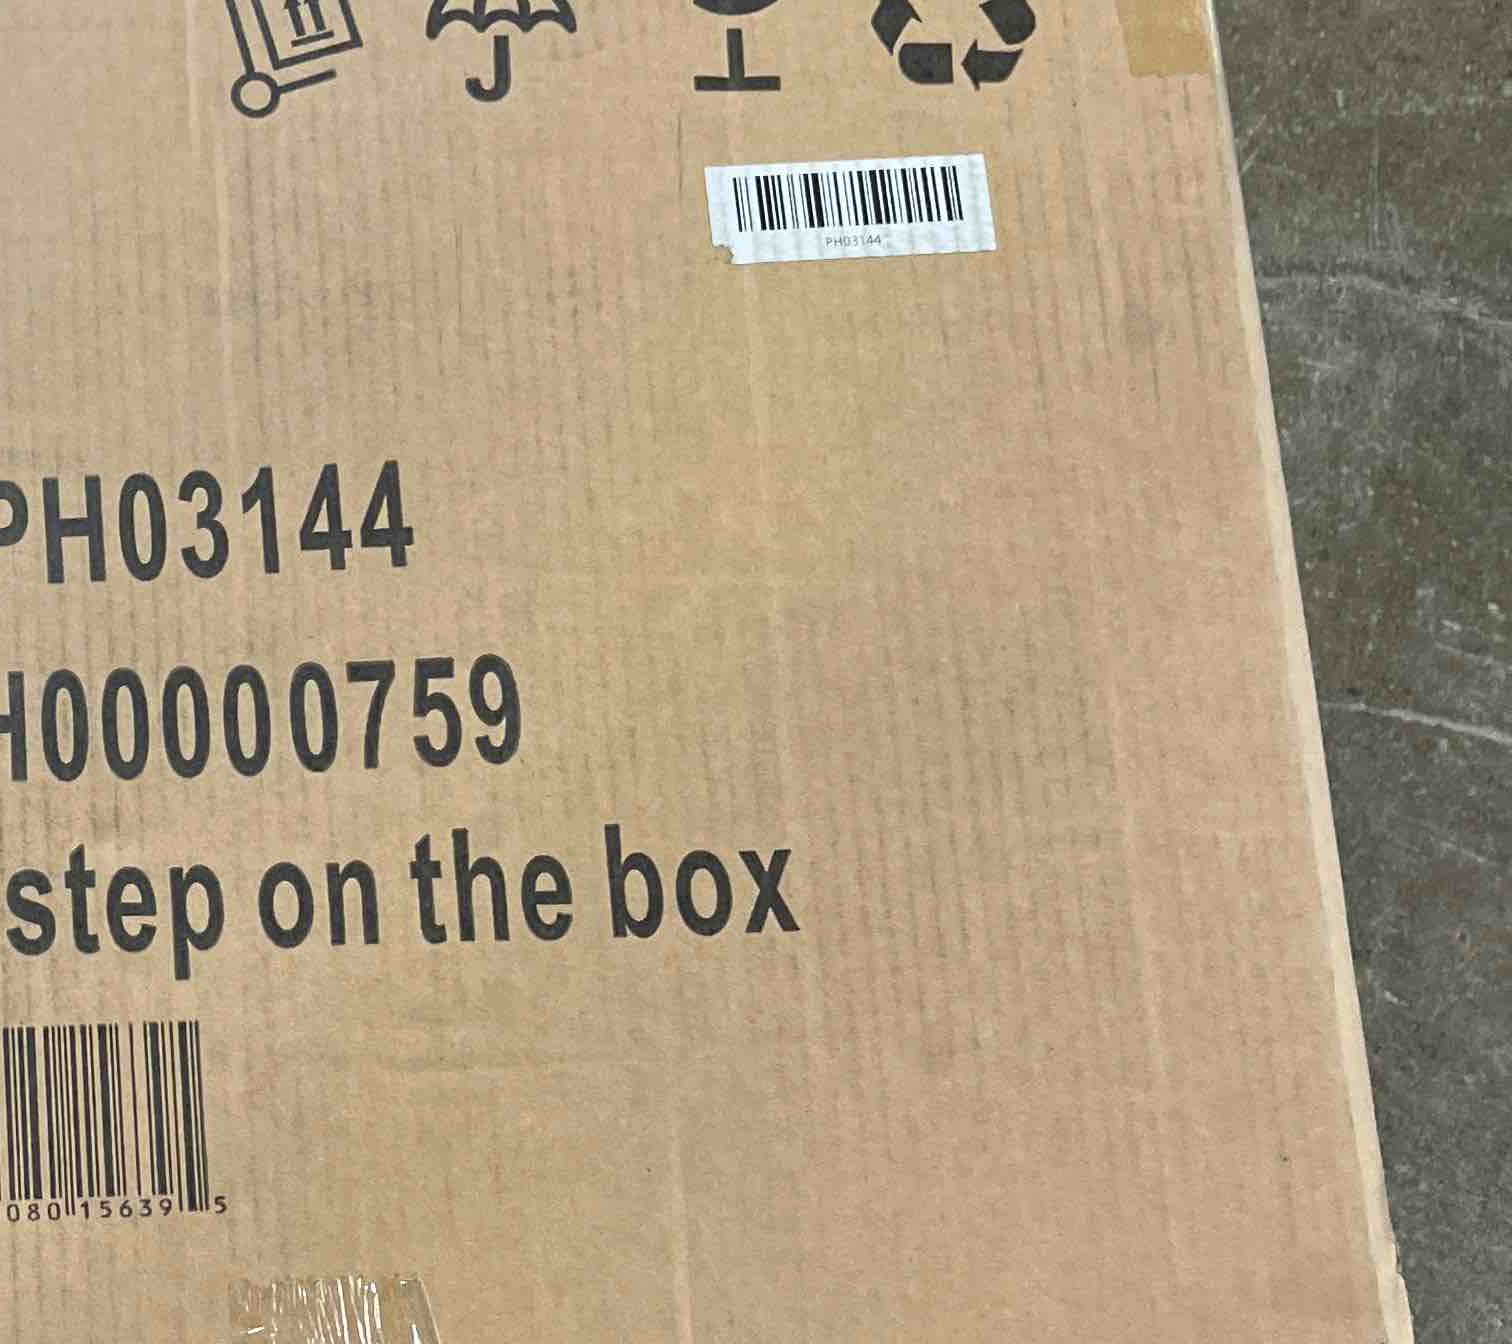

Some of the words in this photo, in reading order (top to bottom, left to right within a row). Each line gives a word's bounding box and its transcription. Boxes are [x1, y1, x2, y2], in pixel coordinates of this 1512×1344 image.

[5, 842, 224, 981] step
[258, 861, 380, 950] on
[409, 827, 574, 945] the
[604, 823, 801, 939] box
[213, 1194, 228, 1214] 5
